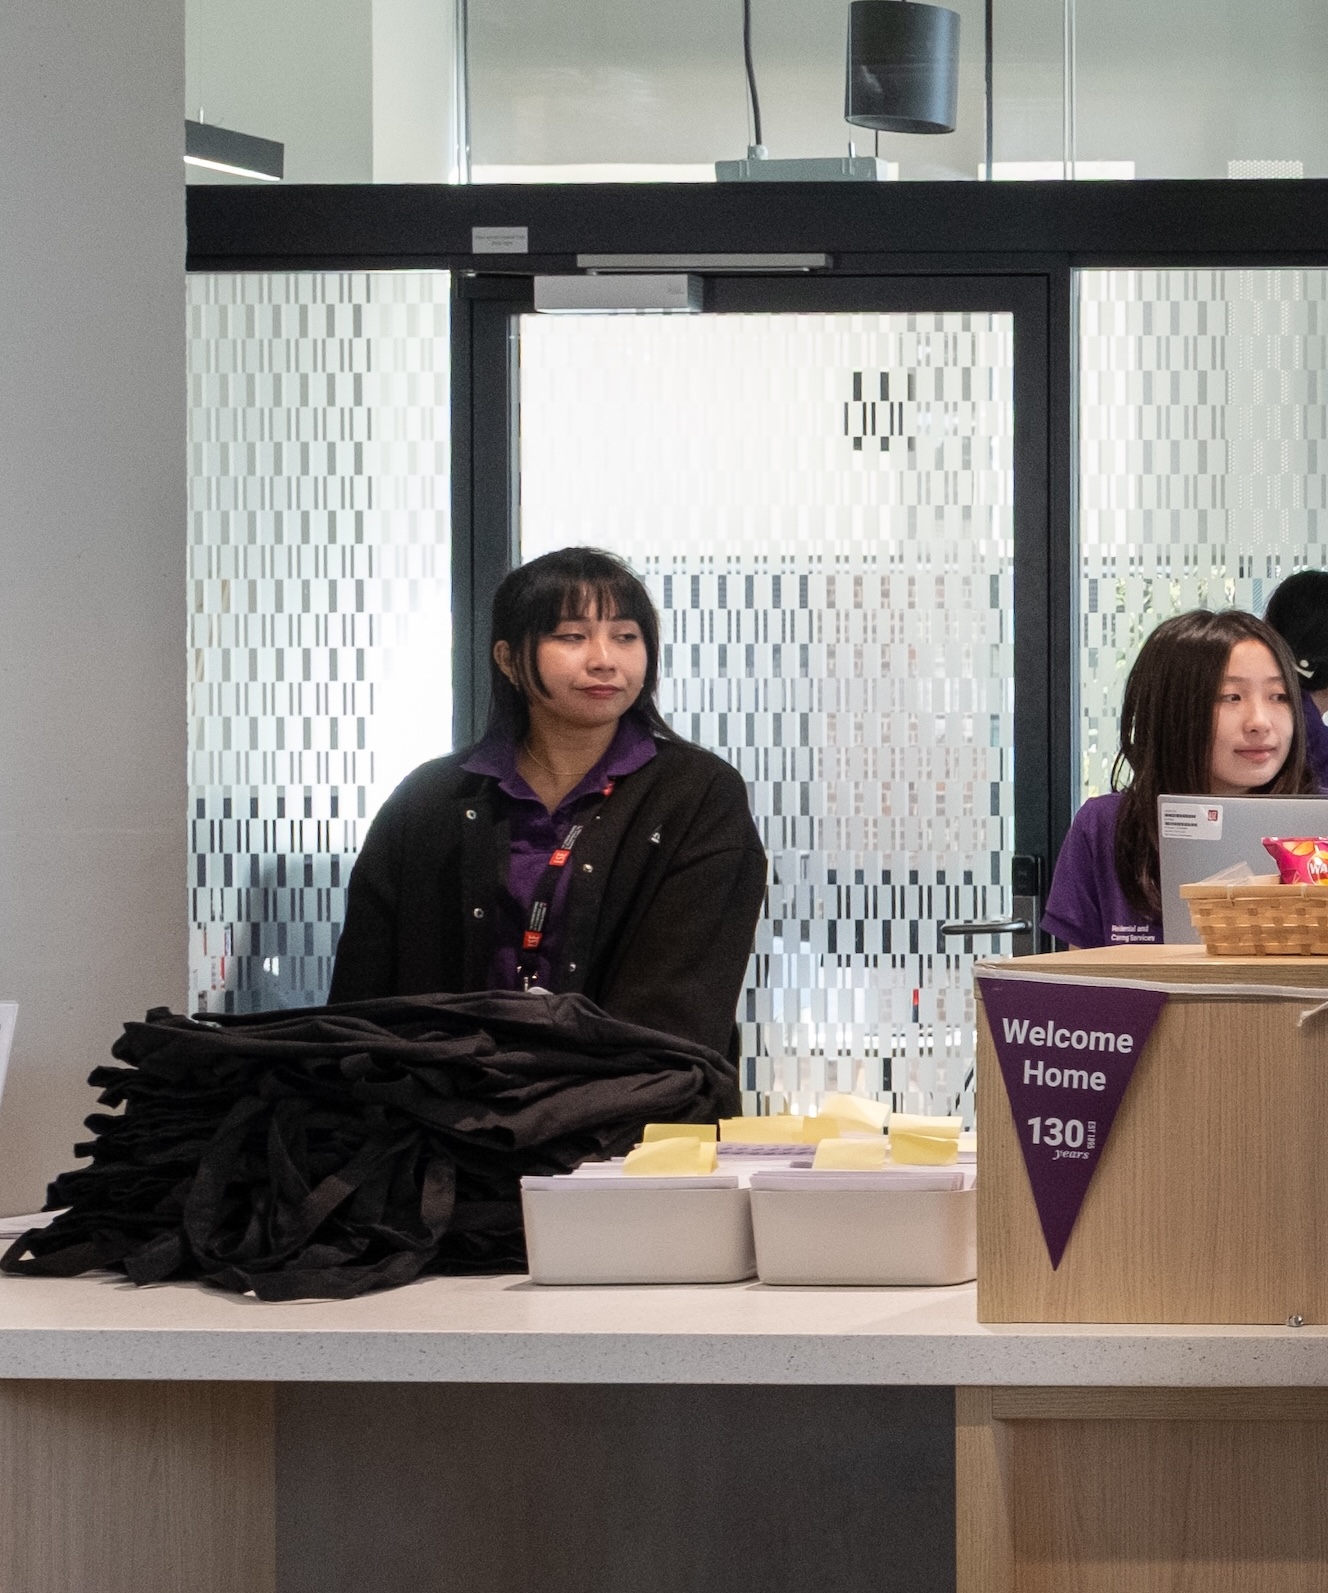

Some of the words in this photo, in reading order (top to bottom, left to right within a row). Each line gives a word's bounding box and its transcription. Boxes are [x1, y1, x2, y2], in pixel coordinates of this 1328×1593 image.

[1002, 1017, 1134, 1054] Welcome
[1023, 1059, 1106, 1091] Home
[1027, 1116, 1084, 1148] 130
[1087, 1120, 1097, 1133] EST
[1052, 1149, 1090, 1160] years
